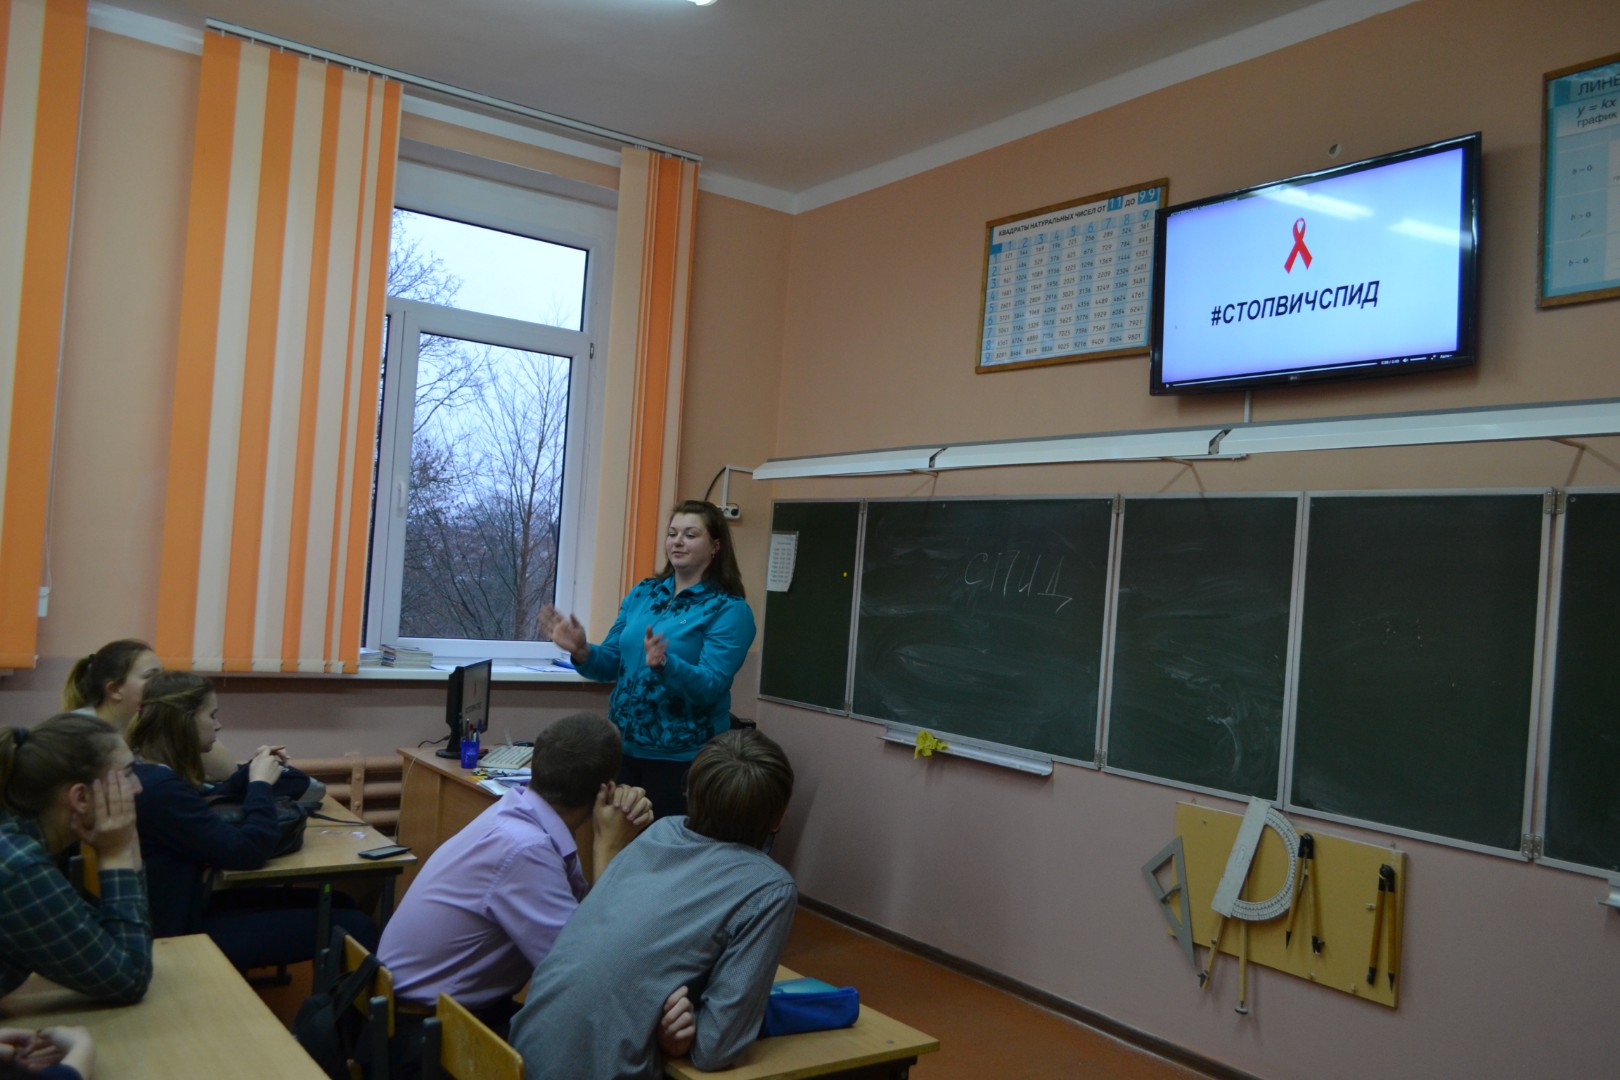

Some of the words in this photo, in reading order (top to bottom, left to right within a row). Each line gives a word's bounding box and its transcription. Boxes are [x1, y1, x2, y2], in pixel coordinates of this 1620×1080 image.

[1577, 111, 1617, 128] график
[998, 224, 1029, 237] КВАДРАТЫ
[1030, 213, 1074, 229] НАТУРАЛЬНЫХ
[1075, 208, 1096, 217] ЧИСЕЛ
[1097, 205, 1106, 213] ОТ
[1109, 198, 1122, 208] 11
[1125, 199, 1136, 208] ДО
[1140, 188, 1155, 202] 99
[1023, 237, 1028, 248] 2
[1038, 234, 1044, 244] 3
[1071, 226, 1076, 236] 5
[1088, 222, 1094, 233] 6
[1105, 218, 1112, 228] 7
[1124, 214, 1130, 225] 8
[1143, 210, 1149, 220] 9
[1211, 281, 1380, 326] #СТОПВИЧСПИД
[964, 550, 1073, 613] СПИД
